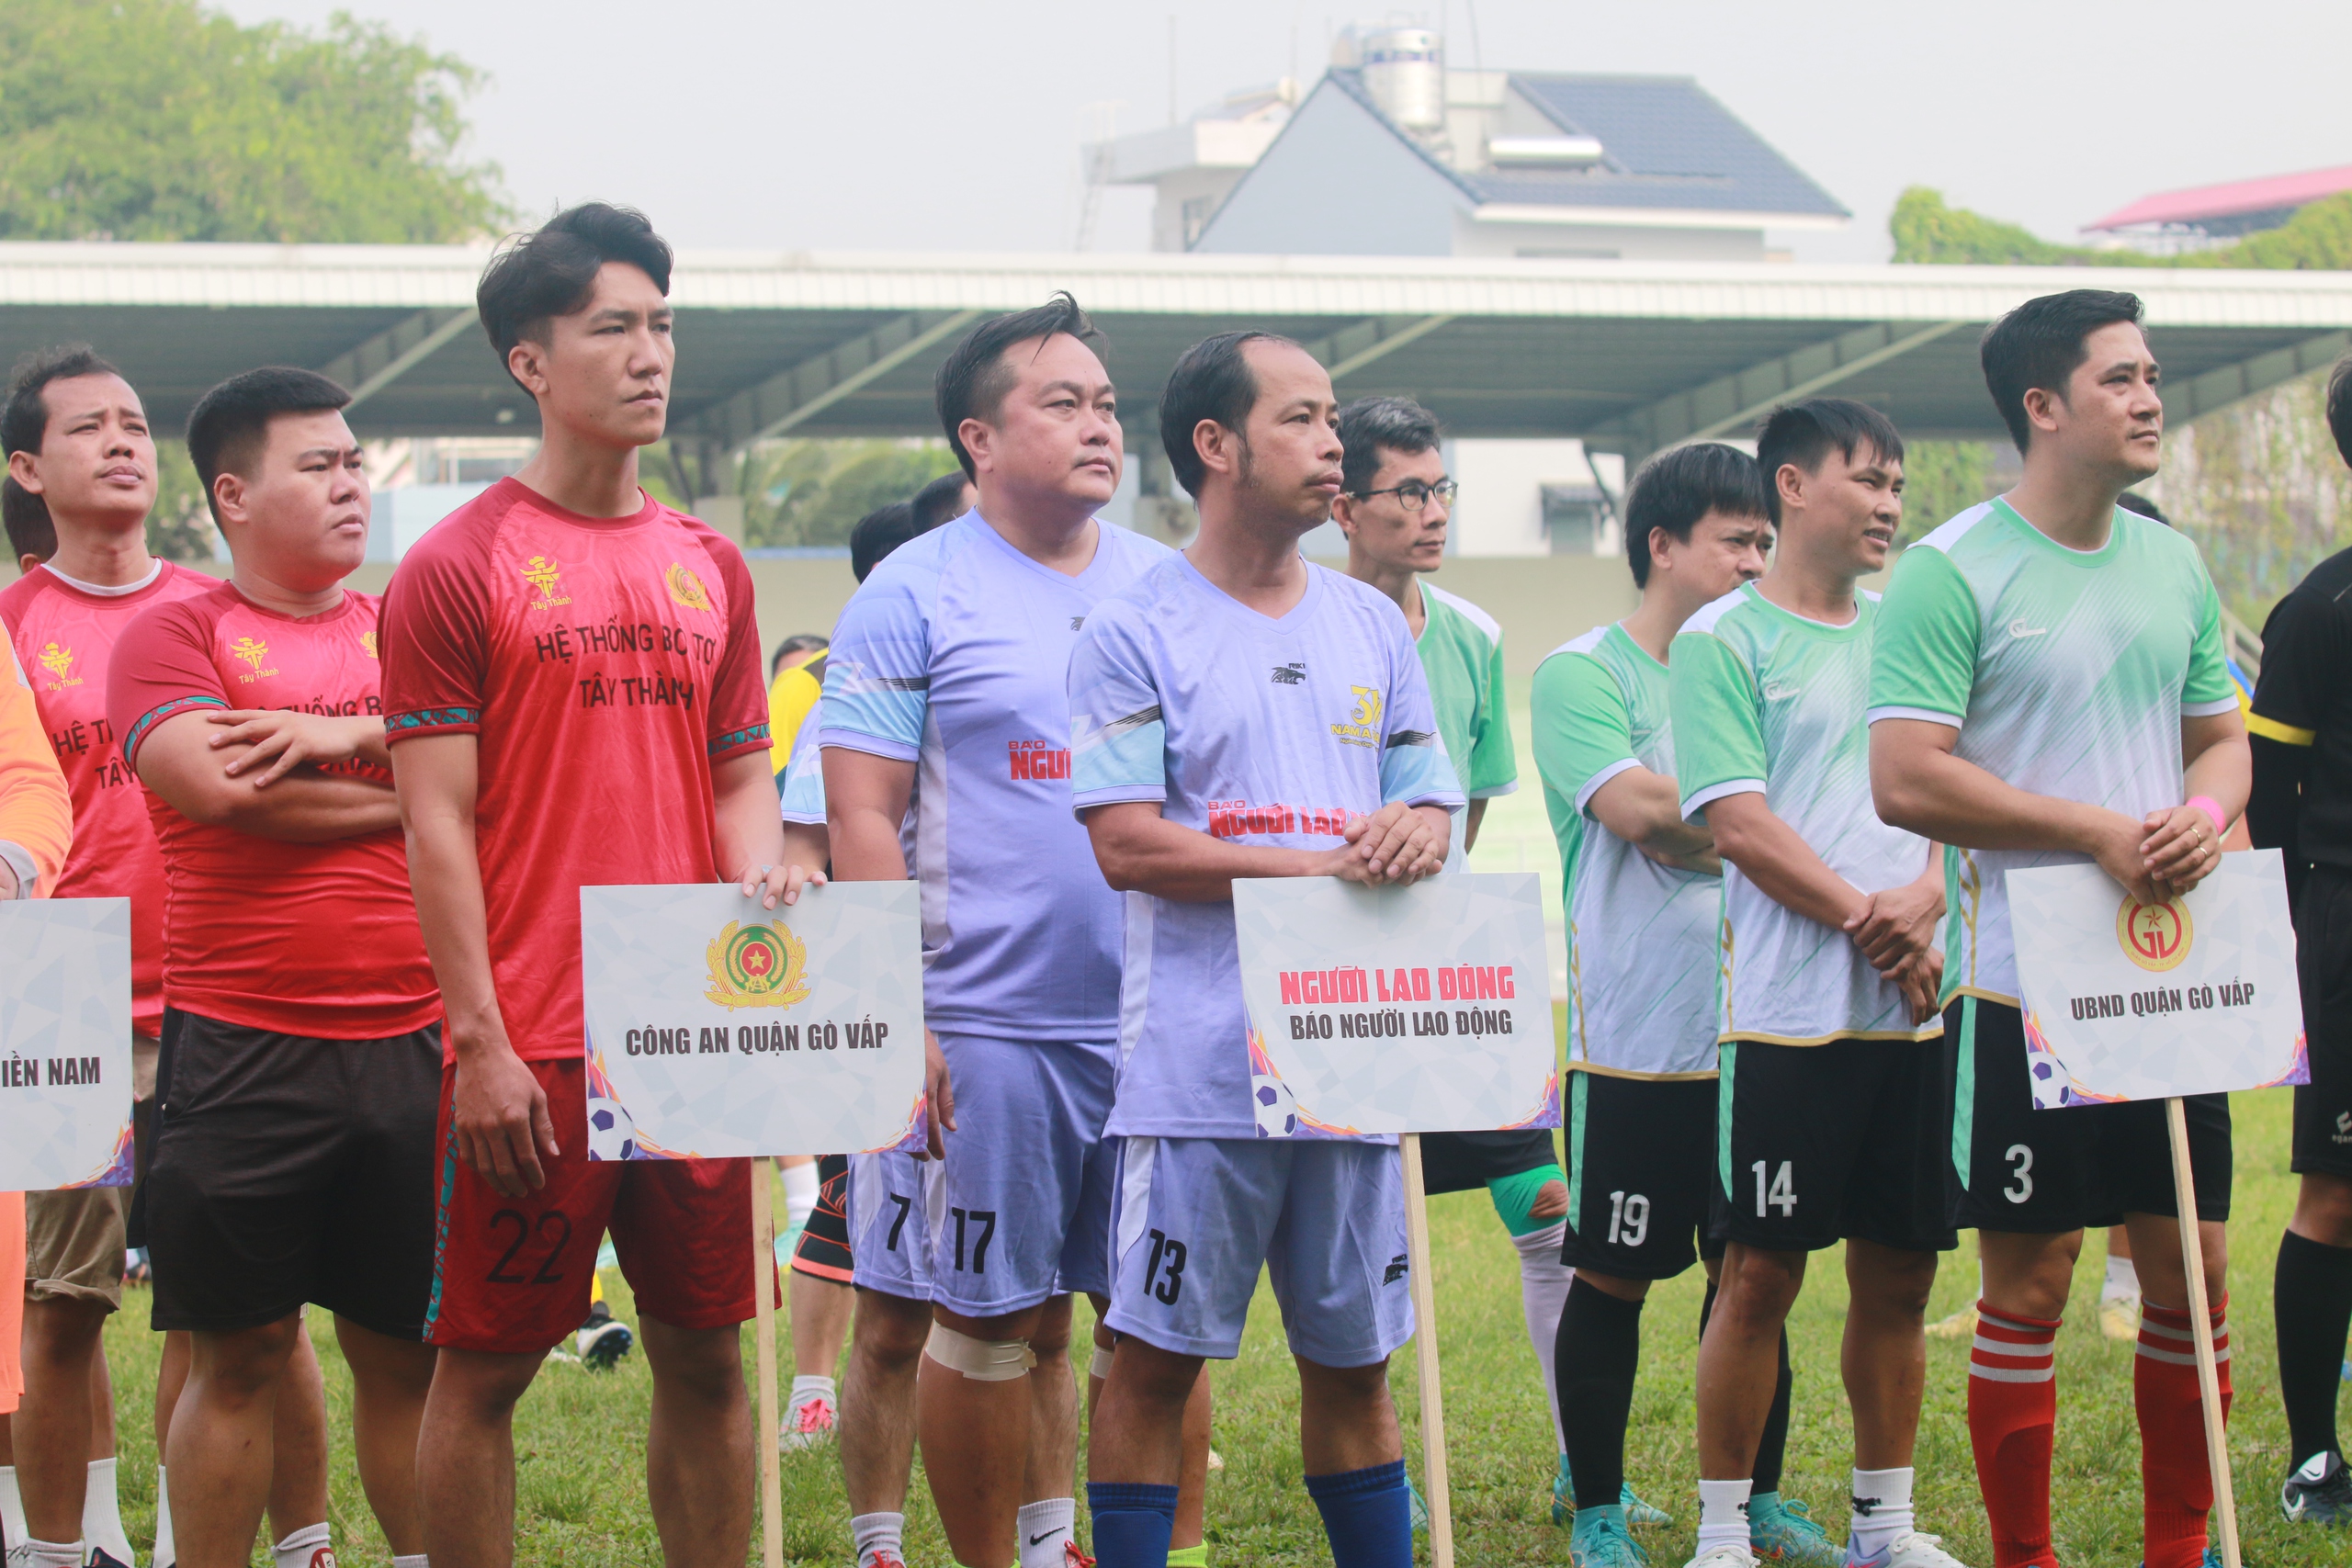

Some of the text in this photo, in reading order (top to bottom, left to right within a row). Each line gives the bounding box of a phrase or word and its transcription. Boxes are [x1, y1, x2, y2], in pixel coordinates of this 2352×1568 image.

[531, 595, 572, 611] Tây Thành
[535, 615, 717, 665] HỆ THỐNG BÒ TƠ
[48, 677, 84, 691] Tây Thành
[239, 668, 279, 684] Tây Thành
[580, 671, 617, 708] TÂY
[52, 717, 89, 757] HỆ
[1008, 739, 1046, 750] BÁO
[1330, 724, 1360, 738] NAM
[1361, 728, 1372, 739] A
[95, 756, 134, 789] TÂY
[1207, 800, 1247, 810] BÁO
[1208, 802, 1295, 839] NGƯỜI
[1279, 963, 1515, 1005] NGƯỜI LAO ĐỘNG
[2071, 976, 2255, 1021] UBND QUẬN GÒ VẤP
[626, 1013, 888, 1056] CÔNG AN QUẬN GÒ VẤP
[1290, 1006, 1512, 1040] BÁO NGƯỜI LAO ĐỘNG
[2, 1050, 100, 1088] IỀN NAM
[1752, 1160, 1798, 1217] 14
[2004, 1144, 2033, 1203] 3
[888, 1191, 910, 1251] 7
[1608, 1190, 1650, 1247] 19
[486, 1209, 572, 1284] 22
[951, 1206, 996, 1274] 17
[1144, 1228, 1187, 1306] 13
